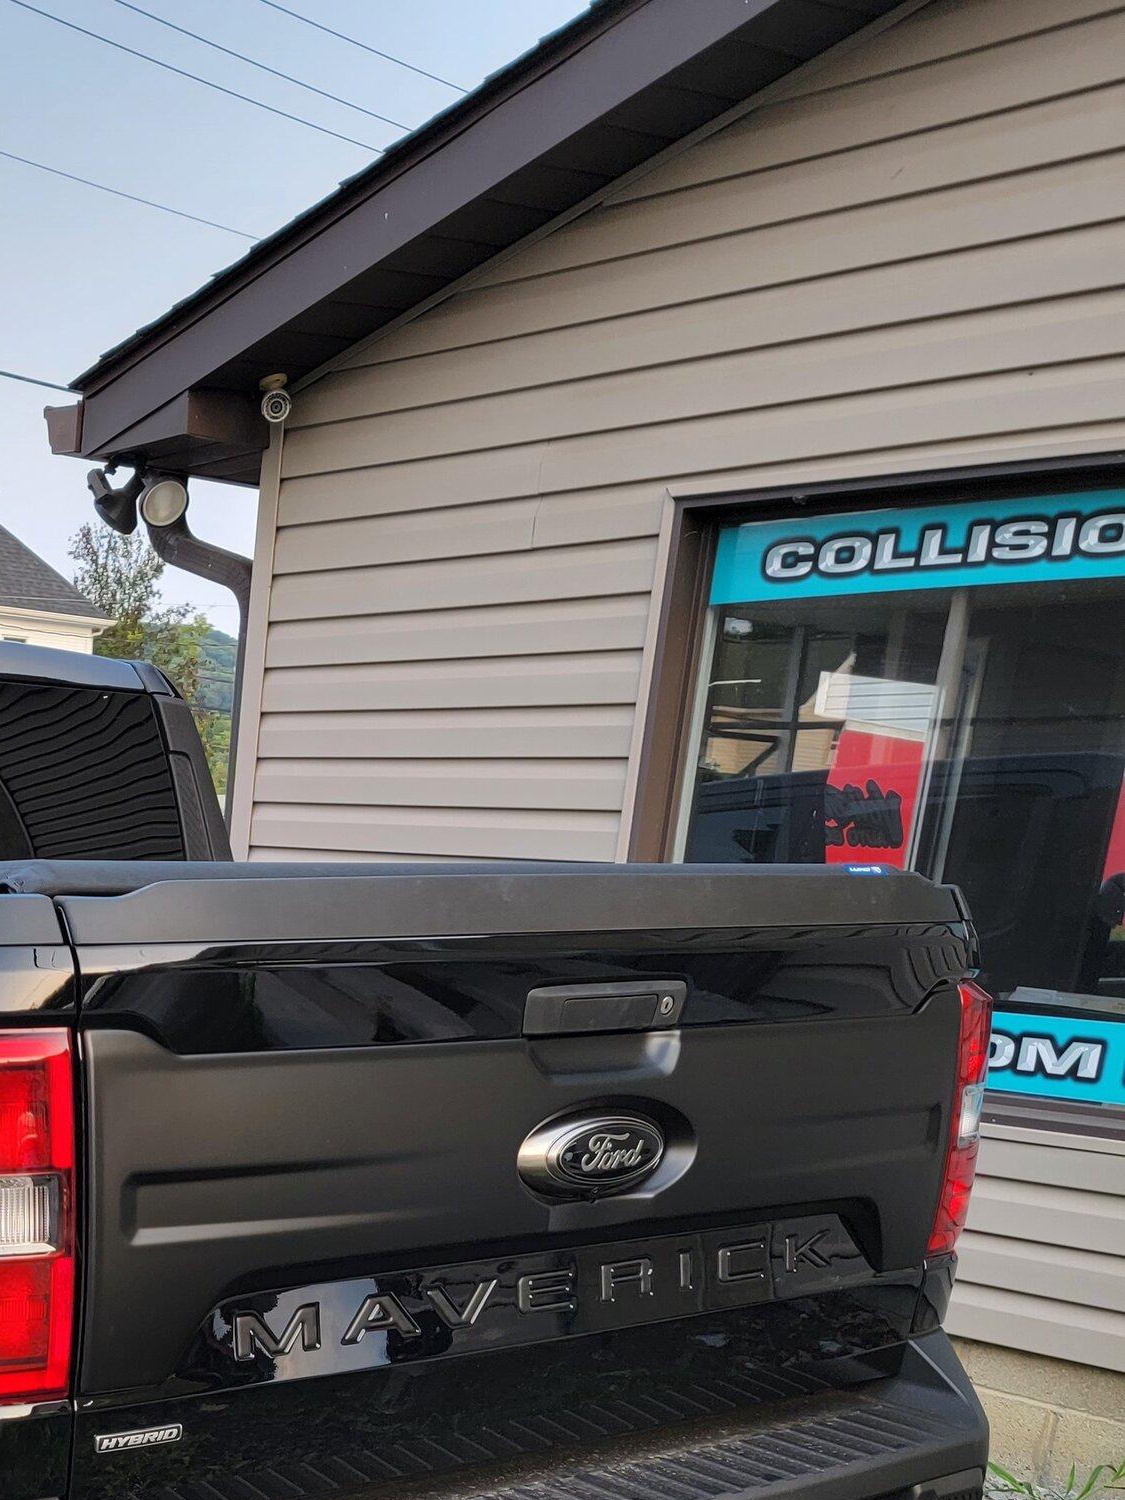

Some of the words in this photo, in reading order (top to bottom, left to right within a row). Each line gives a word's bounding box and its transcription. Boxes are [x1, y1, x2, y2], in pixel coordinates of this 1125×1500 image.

[765, 513, 1125, 579] COLLISIO
[581, 1132, 645, 1172] Ford
[232, 1228, 832, 1362] MAVERICK
[100, 1428, 178, 1450] HYBRID
